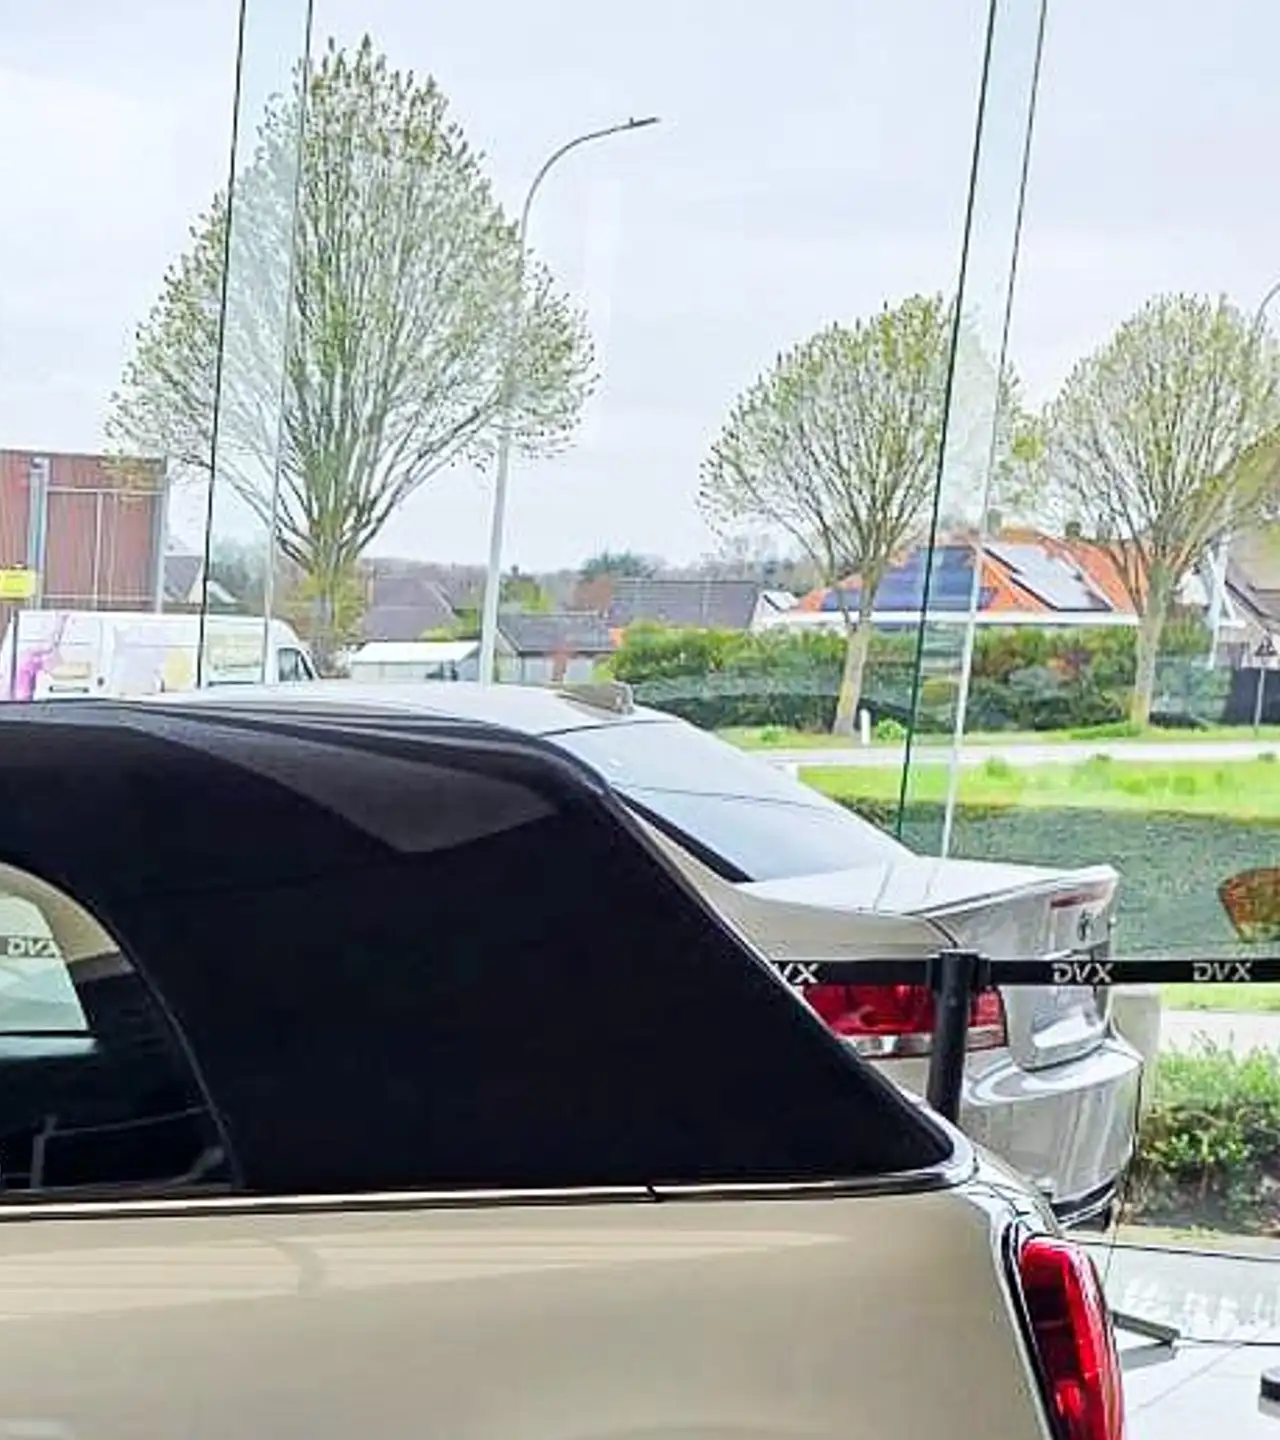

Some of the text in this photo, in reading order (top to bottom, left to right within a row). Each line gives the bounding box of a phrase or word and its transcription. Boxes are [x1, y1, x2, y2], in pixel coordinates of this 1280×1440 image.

[773, 962, 819, 984] VX
[1052, 963, 1114, 983] DVX
[1193, 962, 1251, 981] DVX
